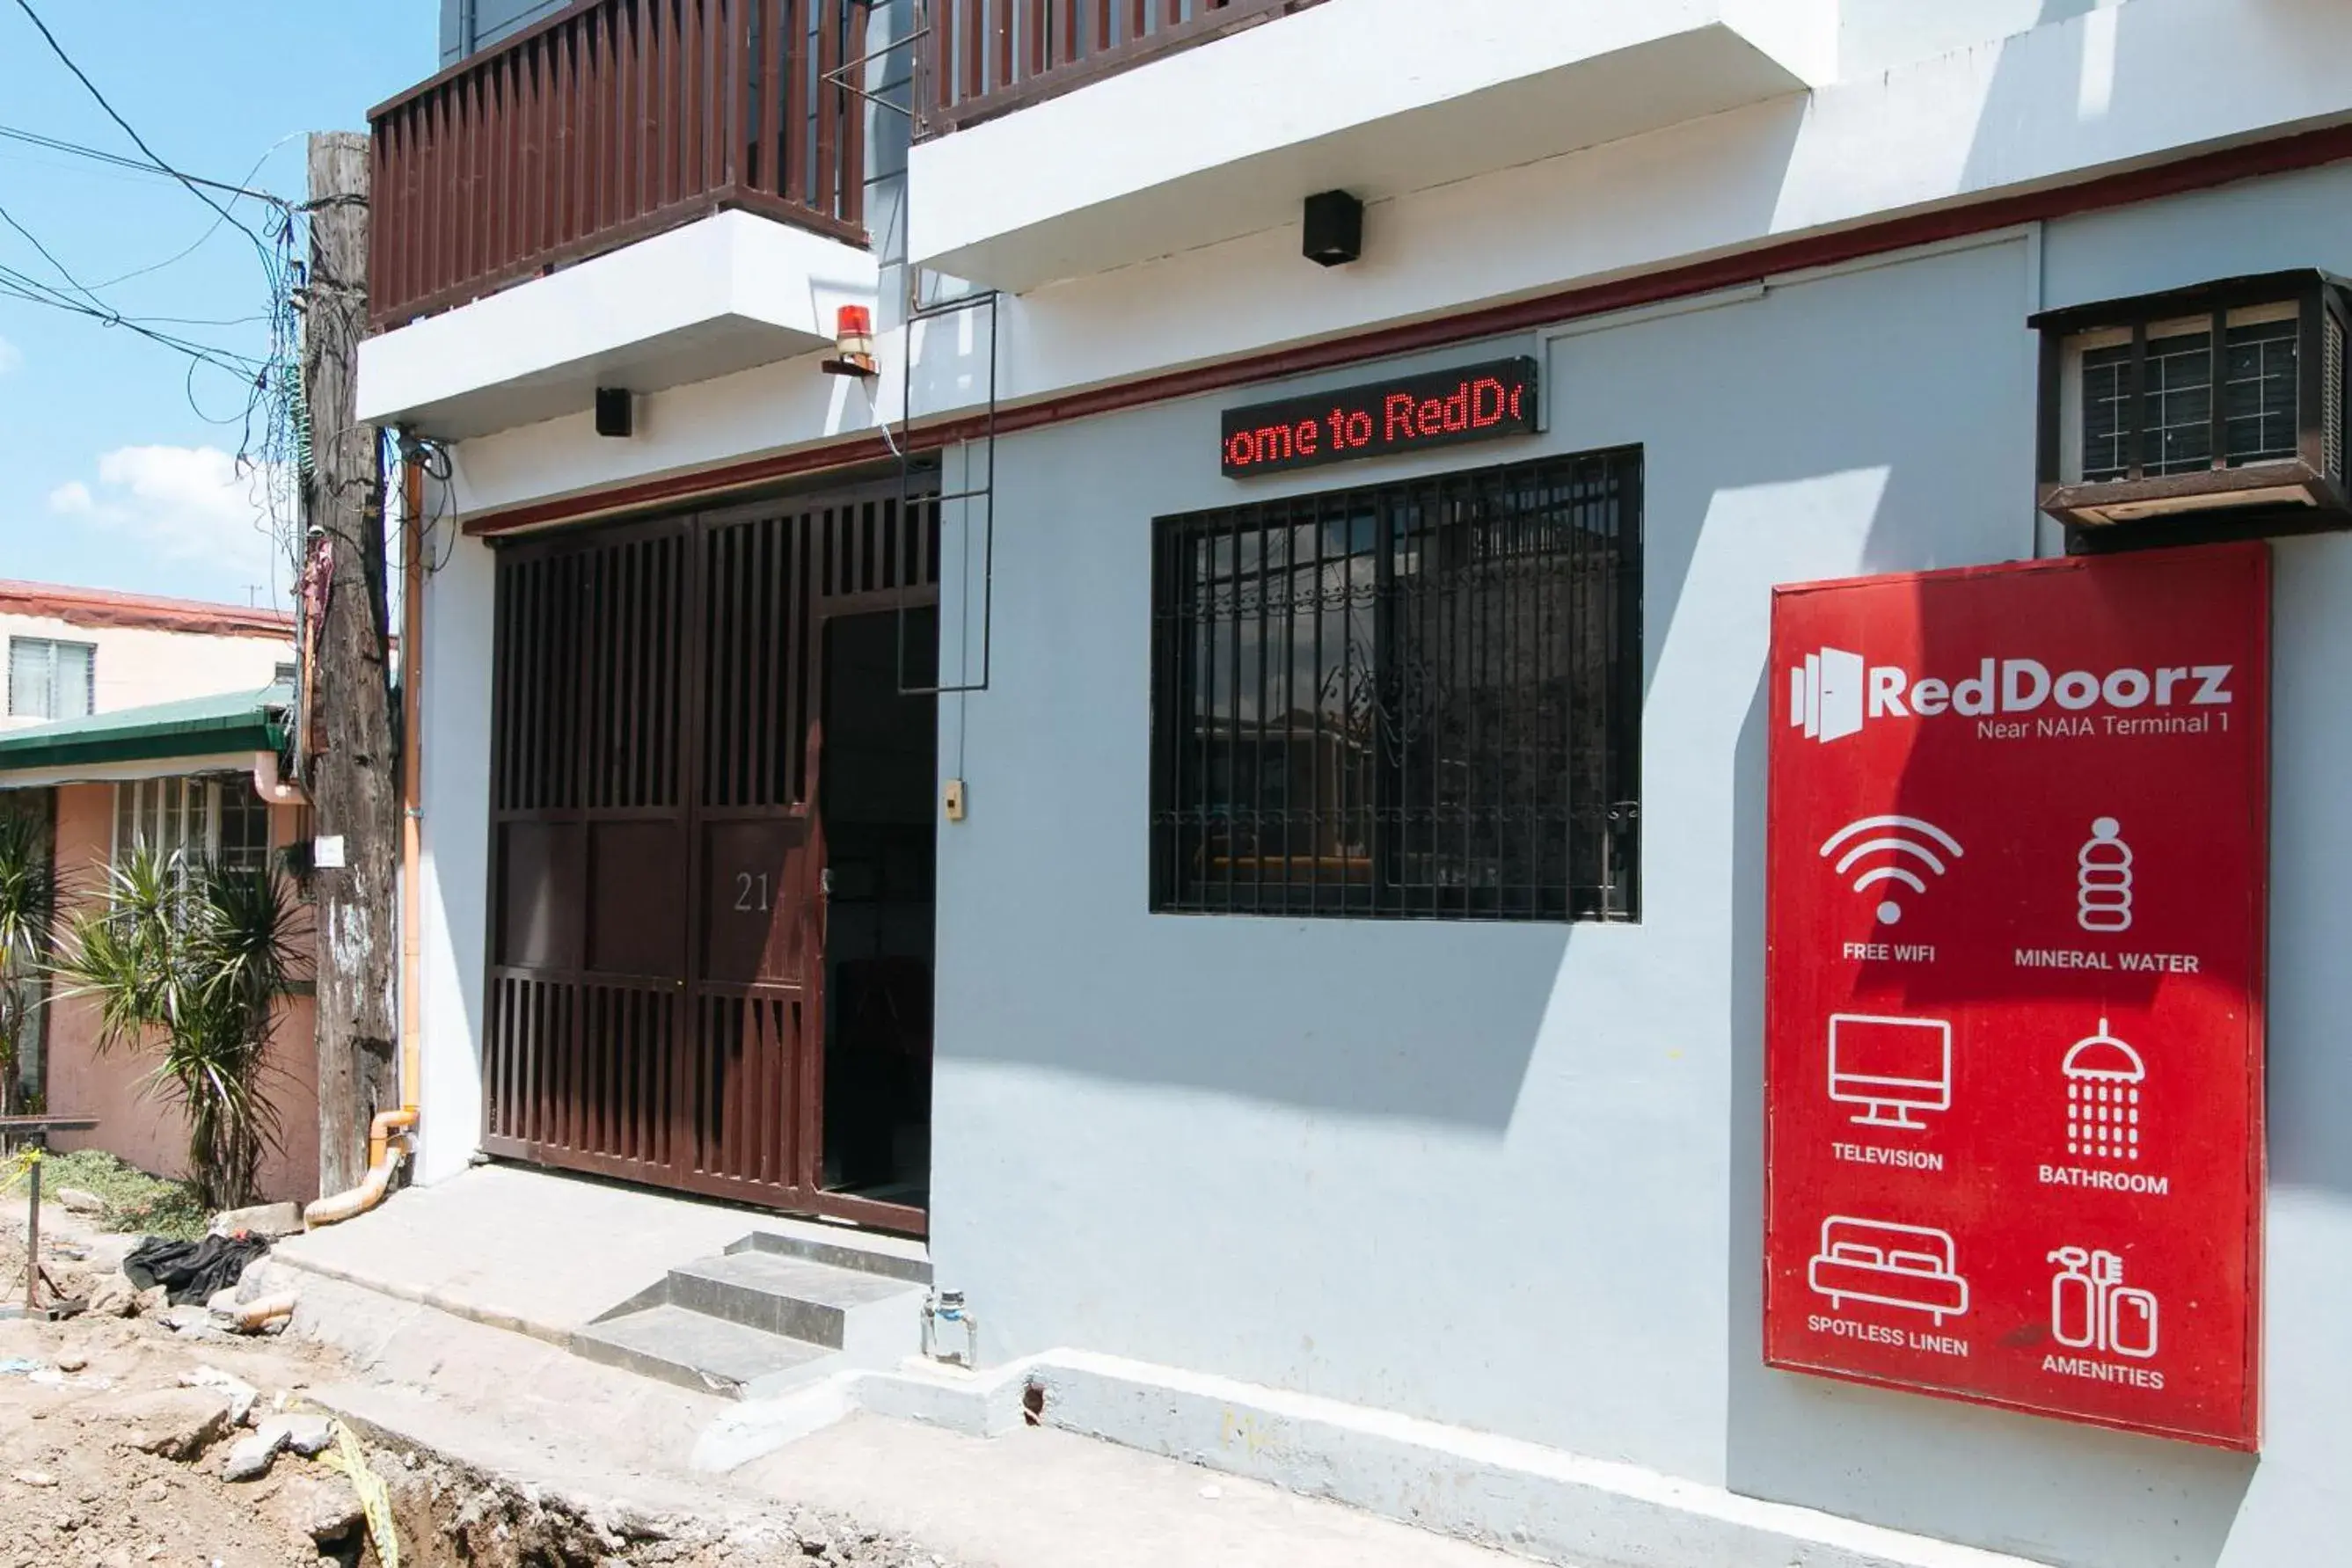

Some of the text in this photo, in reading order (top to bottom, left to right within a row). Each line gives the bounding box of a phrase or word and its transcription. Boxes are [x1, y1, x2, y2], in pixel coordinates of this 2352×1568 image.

[1224, 419, 1318, 465] ome
[1328, 405, 1372, 450] to
[1867, 658, 2233, 718] RedDoorz
[1978, 711, 2229, 740] Near NAIA Terminal 1
[734, 872, 768, 911] 21
[1843, 942, 1935, 963] FREE WIFI
[2014, 949, 2199, 974] MINERAL WATER
[1832, 1142, 1943, 1171] TELEVISION
[2038, 1164, 2168, 1195] BATHROOM
[1808, 1315, 1969, 1357] SPOTLESS LINEN
[2042, 1354, 2165, 1389] AMENITIES
